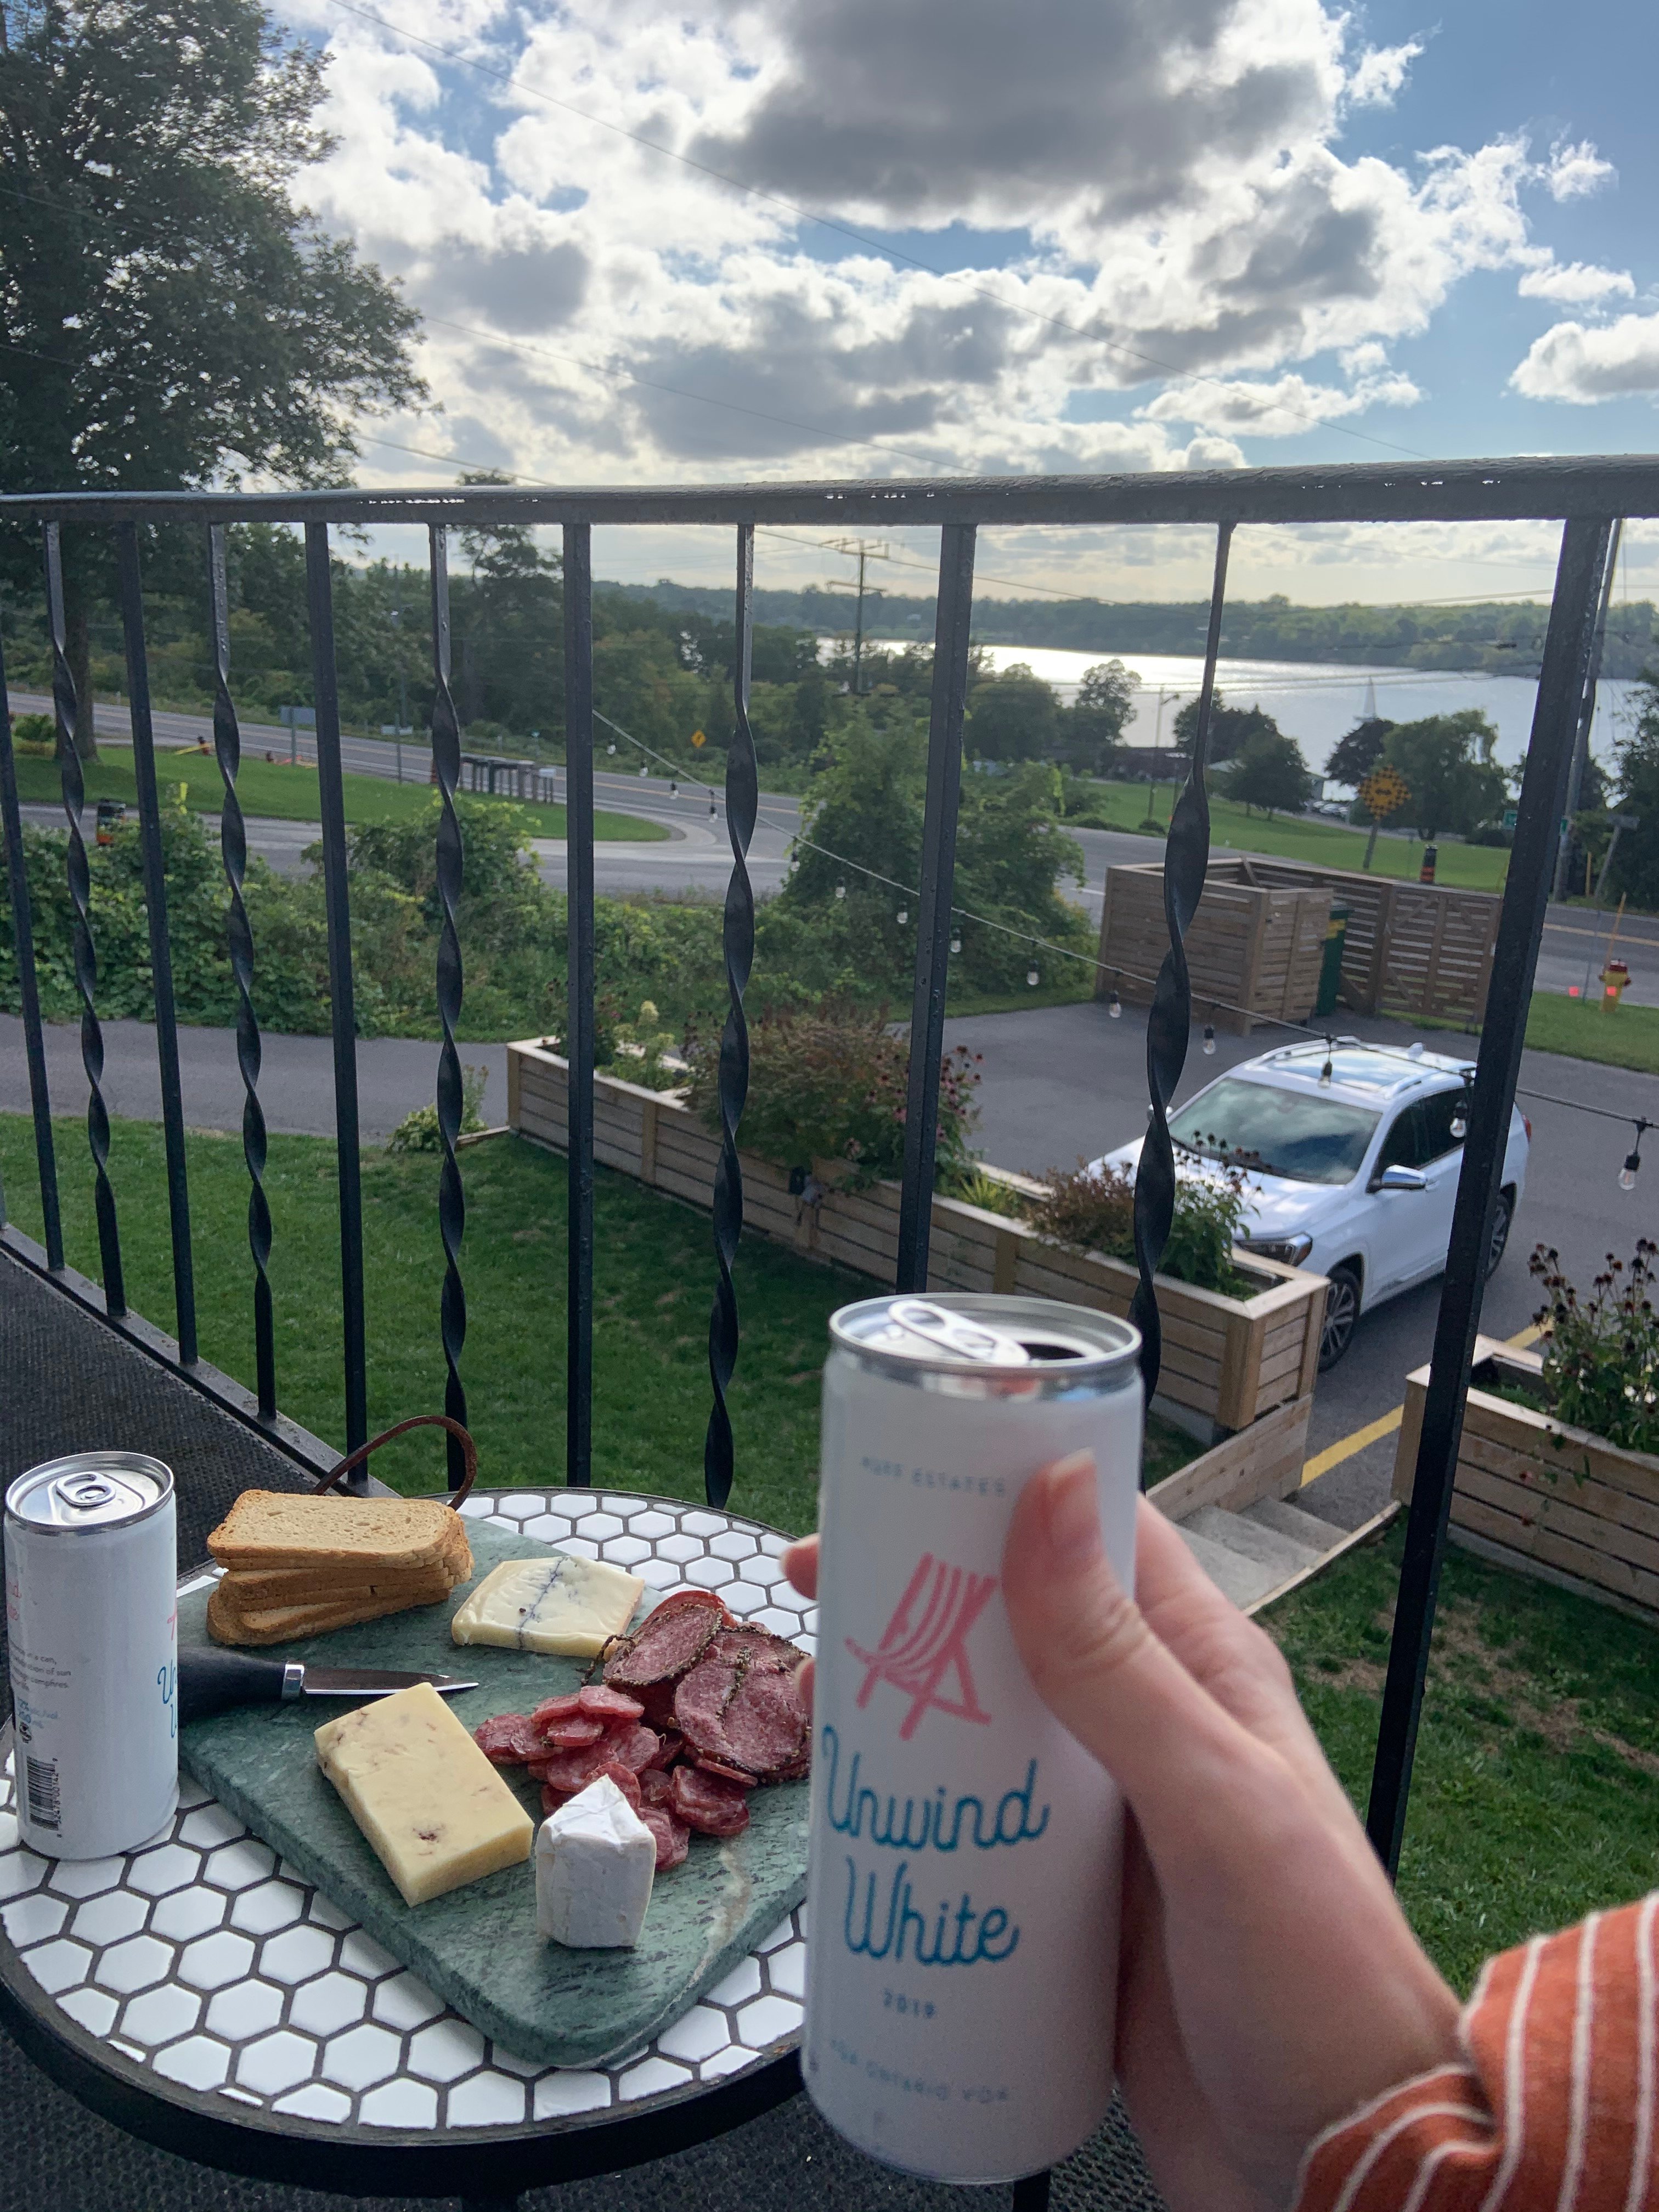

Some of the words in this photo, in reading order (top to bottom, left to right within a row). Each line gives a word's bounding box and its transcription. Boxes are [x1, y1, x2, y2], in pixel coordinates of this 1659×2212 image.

[911, 1467, 1007, 1498] ESTATES
[822, 1724, 1051, 1853] Unwind
[844, 1854, 1021, 1967] White
